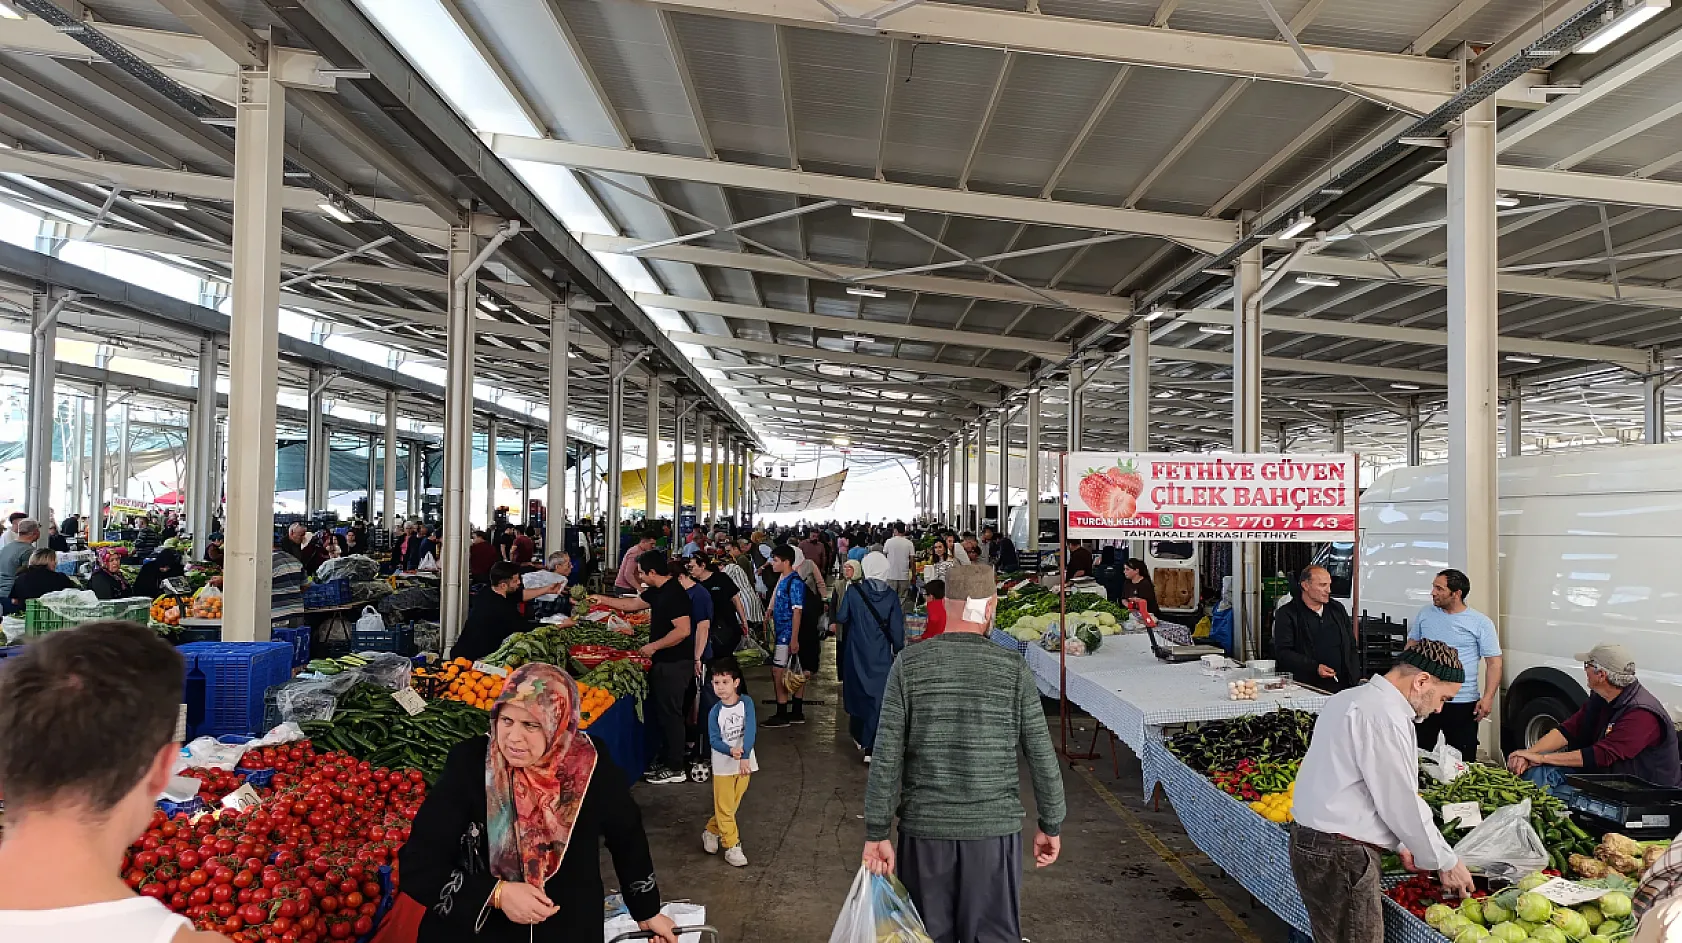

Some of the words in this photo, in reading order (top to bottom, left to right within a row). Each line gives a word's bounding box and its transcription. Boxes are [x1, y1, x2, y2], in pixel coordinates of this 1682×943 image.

[1150, 458, 1255, 480] FETHİYE
[1260, 458, 1345, 480] GÜVEN
[1150, 482, 1228, 510] ÇİLEK
[1233, 482, 1346, 511] BAHÇESİ
[1177, 516, 1229, 528] 0542
[1235, 516, 1274, 528] 770
[1281, 517, 1305, 528] 71
[1312, 517, 1339, 529] 43
[1122, 530, 1195, 538] TAHTAKALE
[1197, 531, 1243, 539] ARKASI
